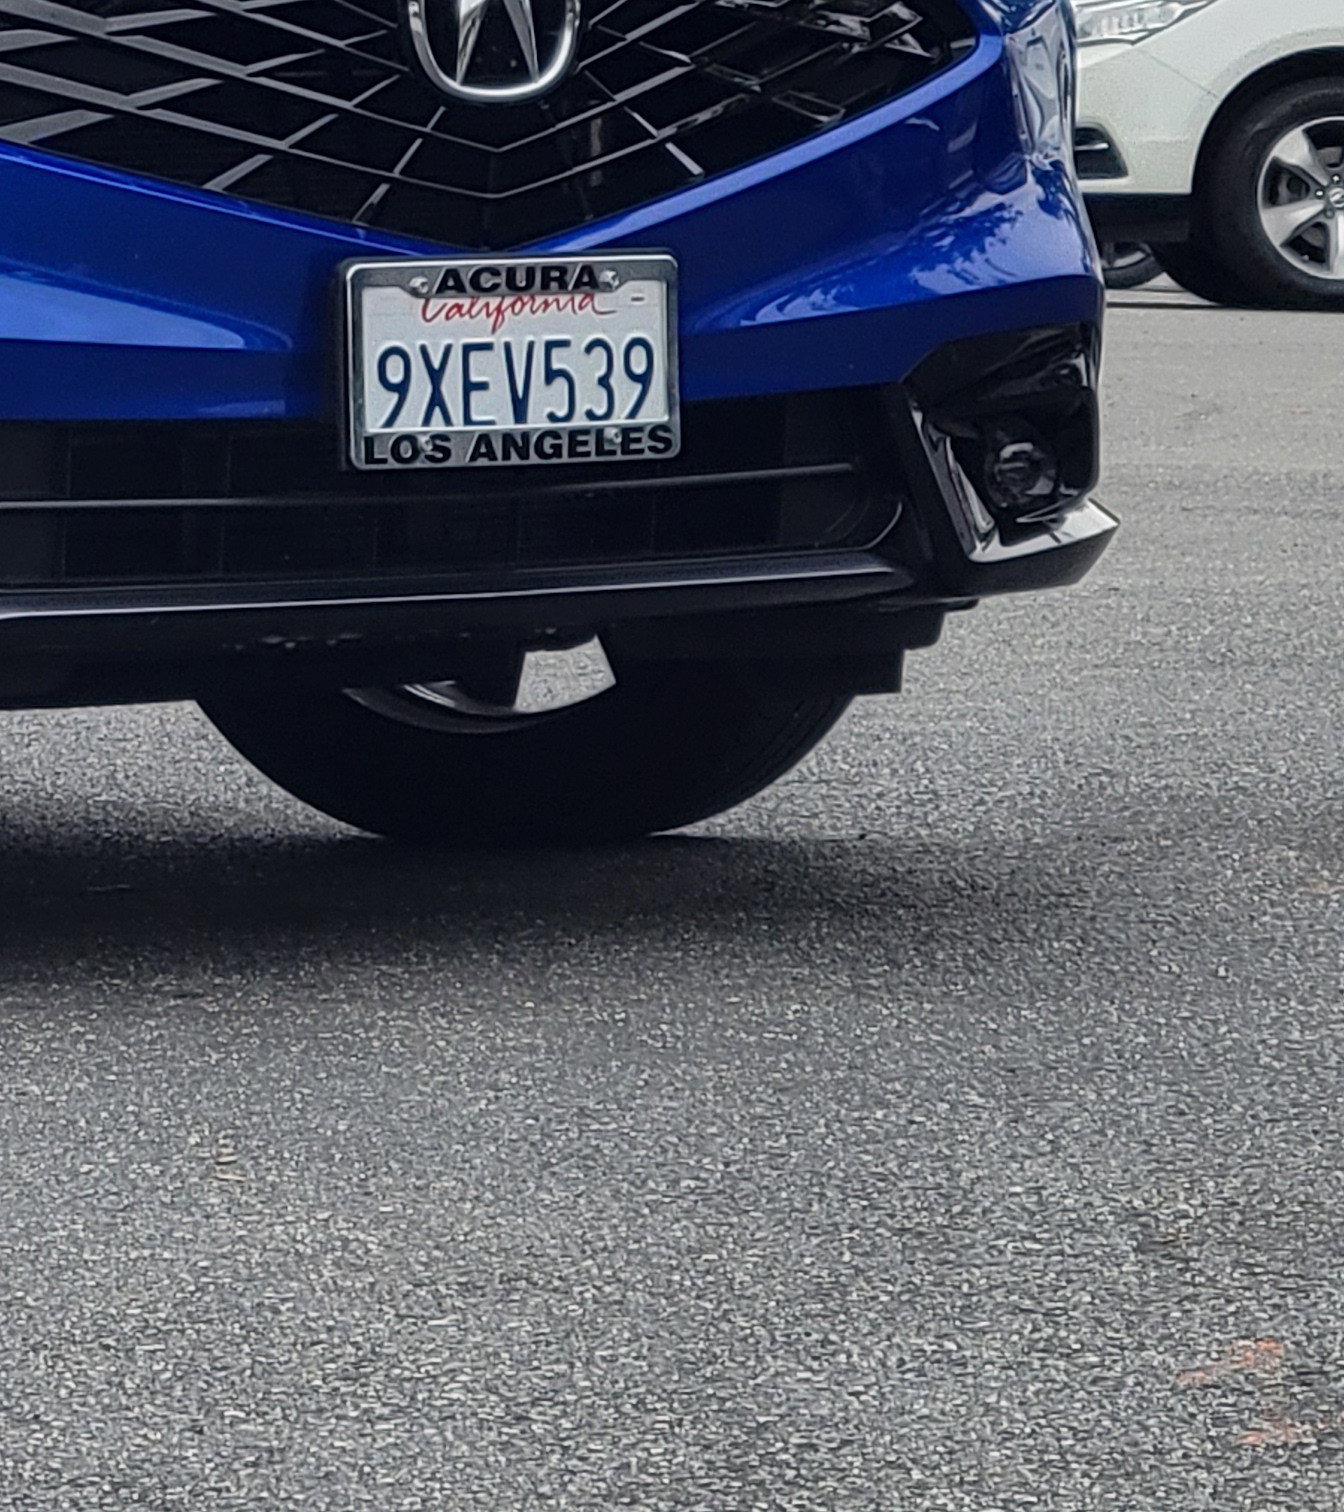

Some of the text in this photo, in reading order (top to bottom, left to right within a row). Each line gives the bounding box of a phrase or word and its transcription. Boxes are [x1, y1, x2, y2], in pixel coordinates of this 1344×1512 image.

[434, 265, 600, 294] ACURA
[420, 293, 617, 335] California
[376, 336, 655, 429] 9XEV539
[363, 424, 675, 466] LOS ANGELES
